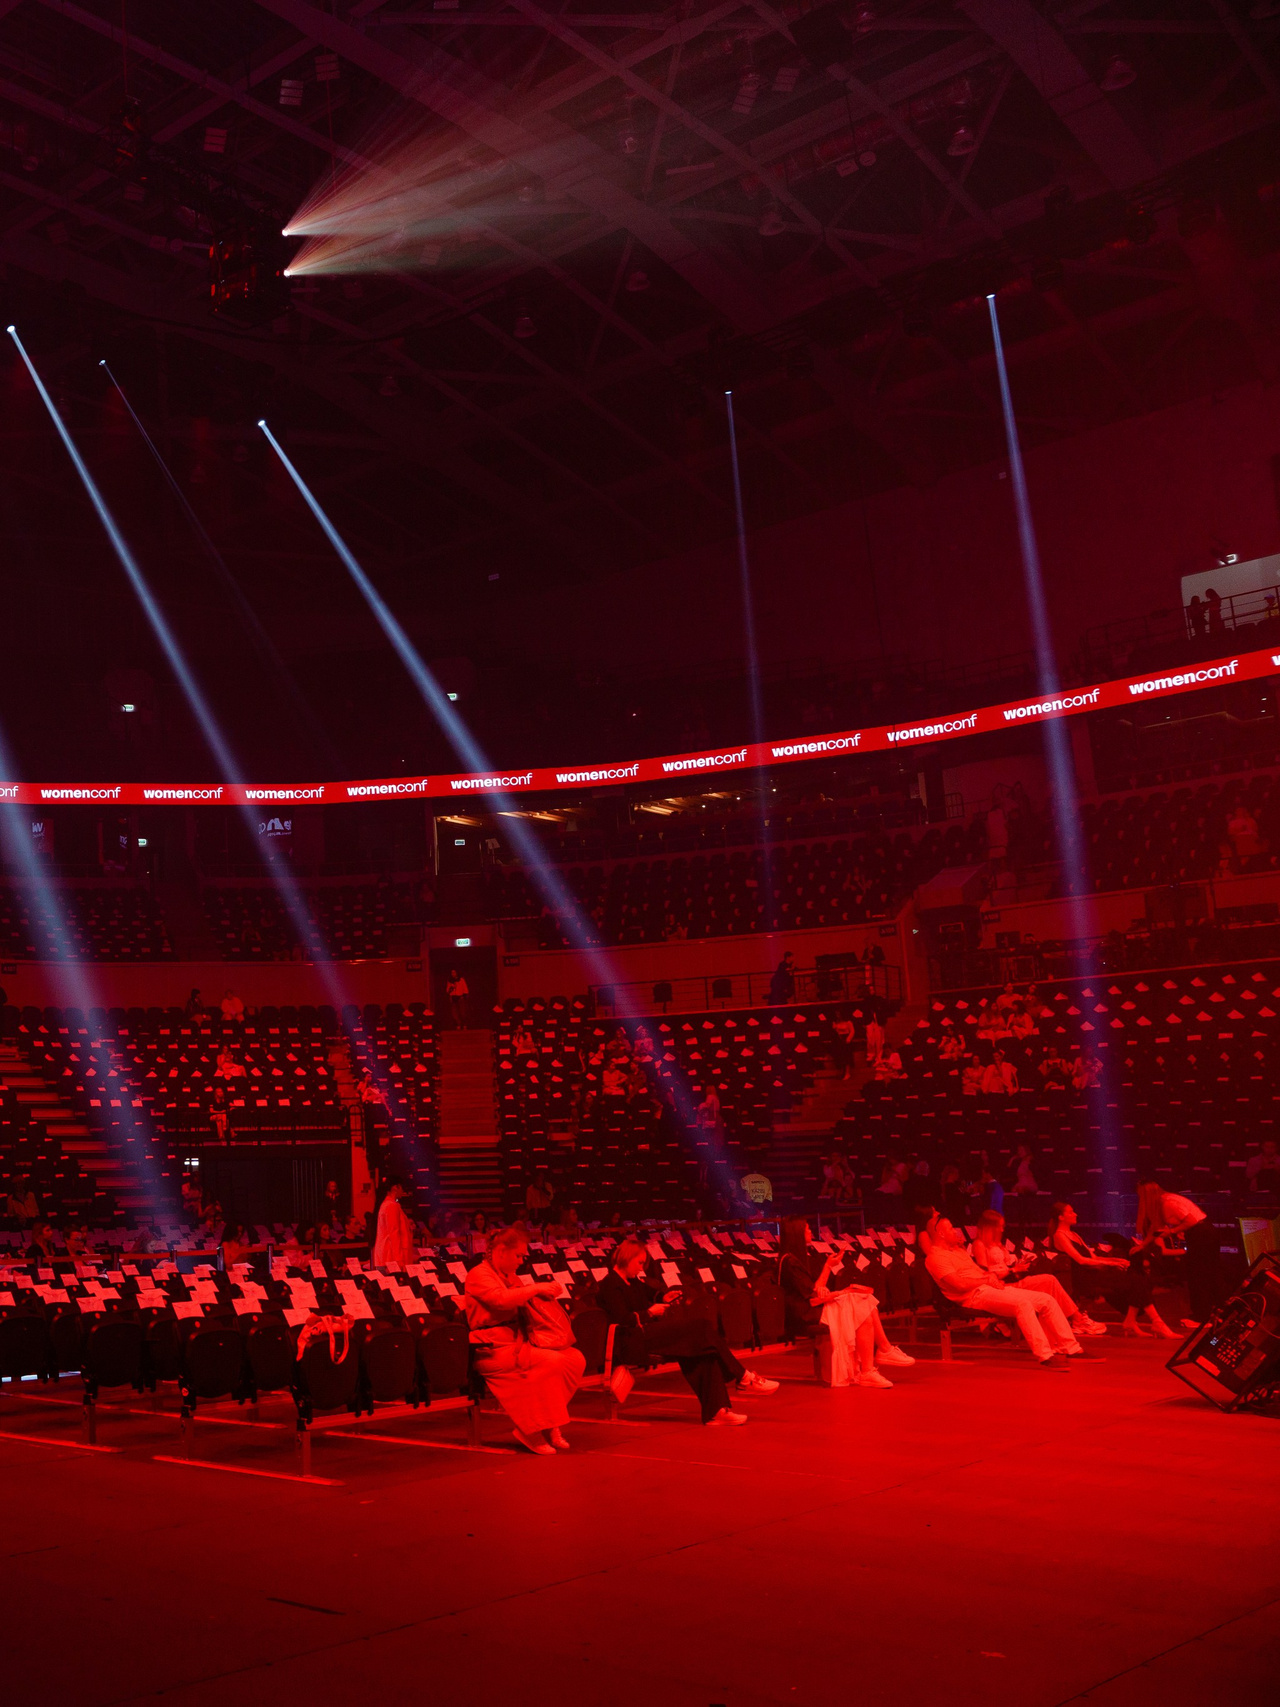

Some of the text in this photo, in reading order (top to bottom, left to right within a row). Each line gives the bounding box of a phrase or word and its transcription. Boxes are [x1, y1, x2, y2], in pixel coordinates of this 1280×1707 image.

[1128, 659, 1239, 695] womenconf
[1002, 687, 1101, 721] womenconf
[886, 713, 978, 742] womenconf
[771, 733, 862, 757] womenconf
[661, 748, 748, 773] womenconf
[450, 772, 533, 792] womenconf
[555, 763, 639, 784] womenconf
[40, 787, 122, 801] womenconf
[143, 787, 224, 801] womenconf
[245, 786, 325, 801] womenconf
[346, 779, 428, 796] womenconf
